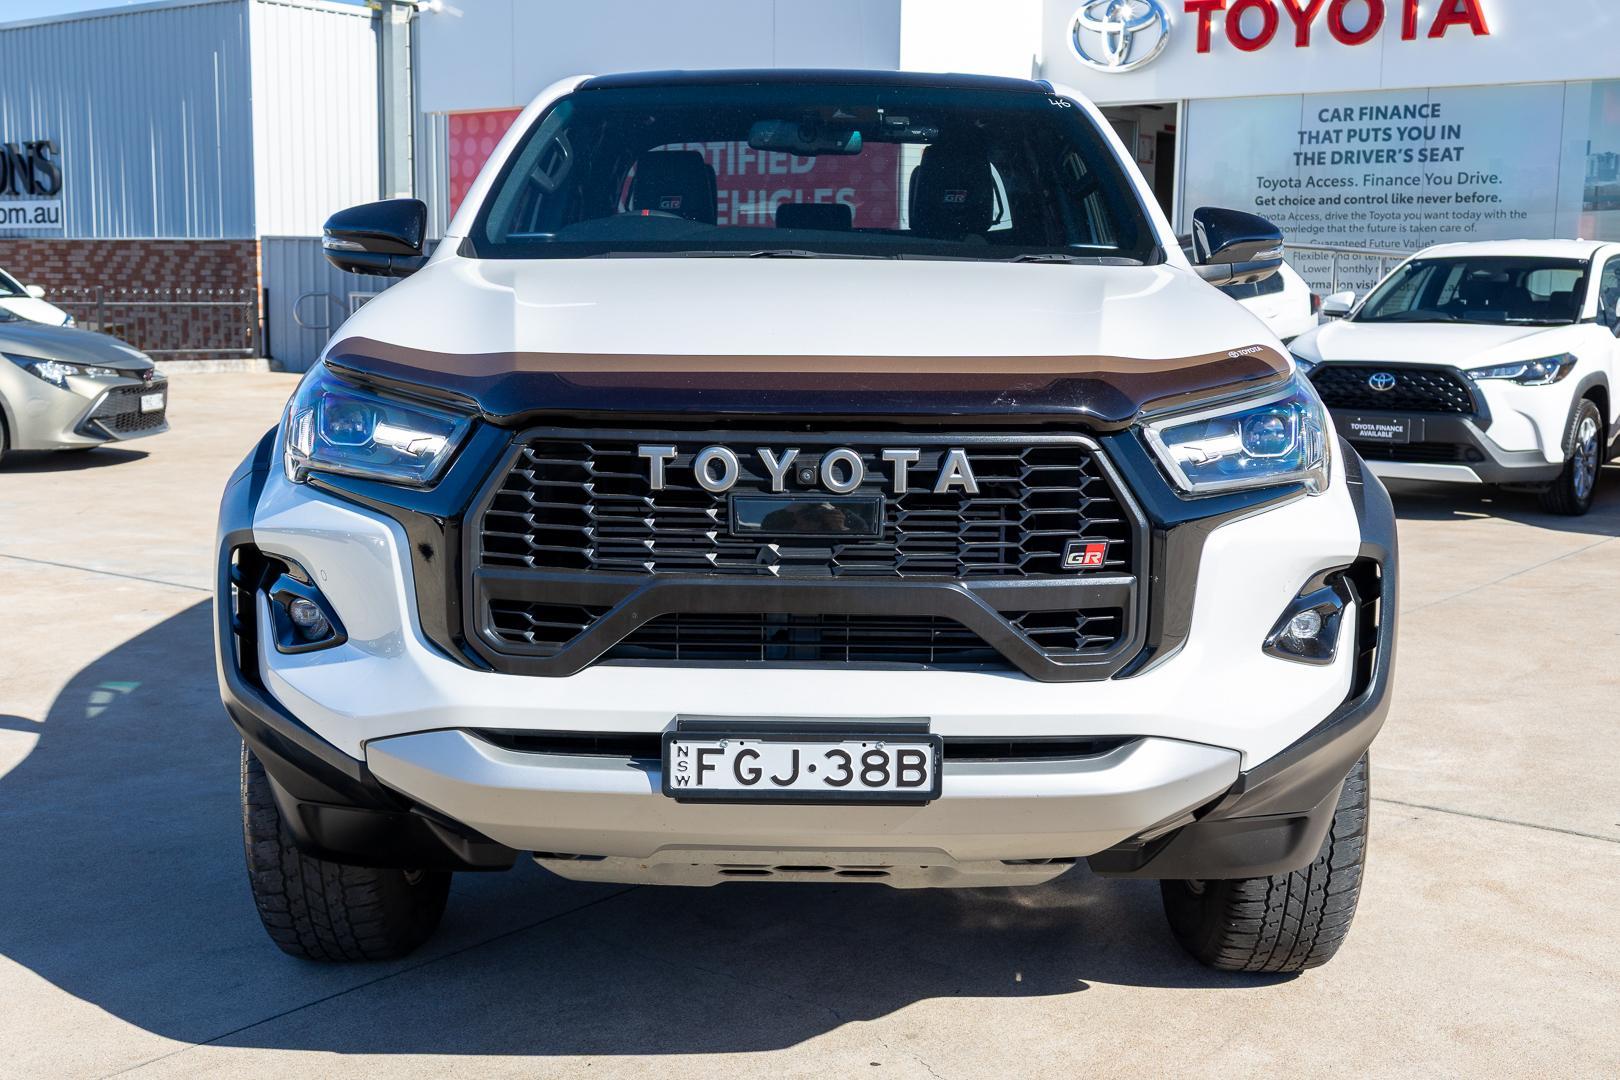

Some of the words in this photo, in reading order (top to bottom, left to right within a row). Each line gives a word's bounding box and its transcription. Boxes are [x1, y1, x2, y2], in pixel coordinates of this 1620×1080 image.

[1184, 0, 1490, 53] TOYOTA
[1318, 108, 1354, 122] CAR
[1358, 103, 1441, 121] FINANCE
[1298, 129, 1343, 145] THAT
[1347, 127, 1392, 143] PUTS
[1397, 125, 1436, 142] YOU
[1441, 124, 1461, 140] IN
[1293, 151, 1326, 166] THE
[1331, 148, 1414, 165] DRIVER'S
[1418, 146, 1464, 163] SEAT
[1256, 176, 1301, 191] Toyota
[1305, 175, 1358, 188] Access.
[1363, 173, 1421, 187] Finance
[1424, 172, 1453, 186] You
[1457, 171, 1502, 185] Drive.
[1255, 195, 1276, 206] Get
[1278, 194, 1316, 206] choice
[1318, 194, 1341, 206] and
[1344, 193, 1388, 205] control
[1391, 192, 1414, 204] like
[1417, 194, 1452, 204] never
[1455, 191, 1502, 203] before.
[1288, 212, 1322, 222] Access,
[1324, 210, 1349, 220] drive
[1351, 210, 1367, 220] the
[1369, 210, 1401, 222] Toyota
[1403, 211, 1421, 222] you
[1424, 210, 1449, 220] want
[1452, 209, 1482, 222] today
[1484, 208, 1507, 219] with
[1509, 208, 1528, 219] the
[1280, 224, 1325, 235] nowledge
[1327, 223, 1346, 233] that
[1348, 223, 1365, 233] the
[1367, 223, 1397, 233] future
[1399, 223, 1407, 232] is
[1409, 223, 1437, 232] taken
[1439, 224, 1461, 232] care
[1464, 222, 1477, 232] of.
[1369, 238, 1401, 248] Future
[1294, 251, 1329, 261] Flexible
[1303, 264, 1331, 273] Lower
[1239, 345, 1264, 356] TOYOTA
[1351, 422, 1375, 431] TOYOTA
[1376, 424, 1403, 433] FINANCE
[1360, 430, 1393, 438] AVAILABLE
[638, 444, 980, 494] TOYOTA
[1067, 551, 1102, 564] GR
